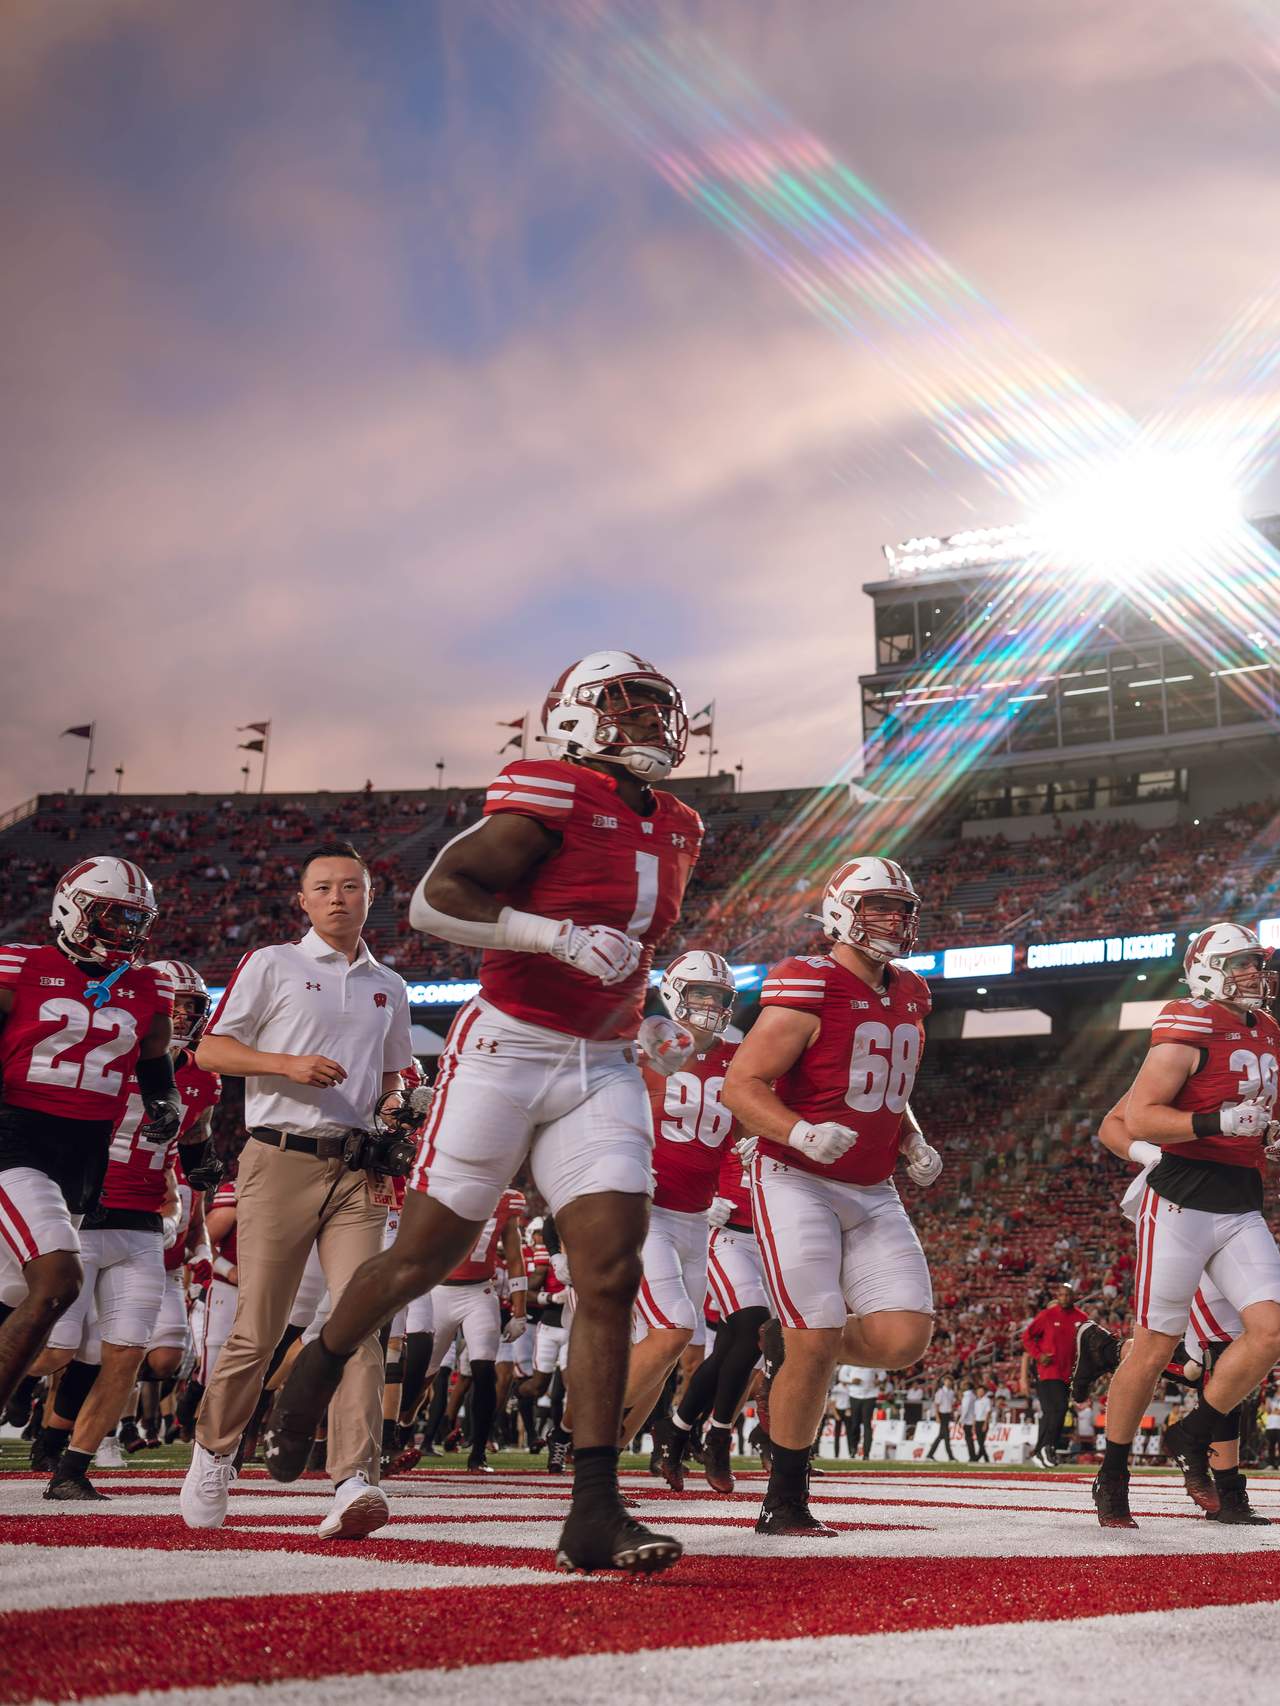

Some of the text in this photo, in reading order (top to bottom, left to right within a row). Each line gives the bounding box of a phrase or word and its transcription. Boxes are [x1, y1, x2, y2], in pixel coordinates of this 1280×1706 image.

[624, 850, 659, 939] 1
[1106, 937, 1122, 962] TO
[1122, 932, 1177, 960] KICKOFF
[26, 997, 138, 1097] 22
[844, 1021, 920, 1114] 68
[660, 1071, 733, 1148] 96
